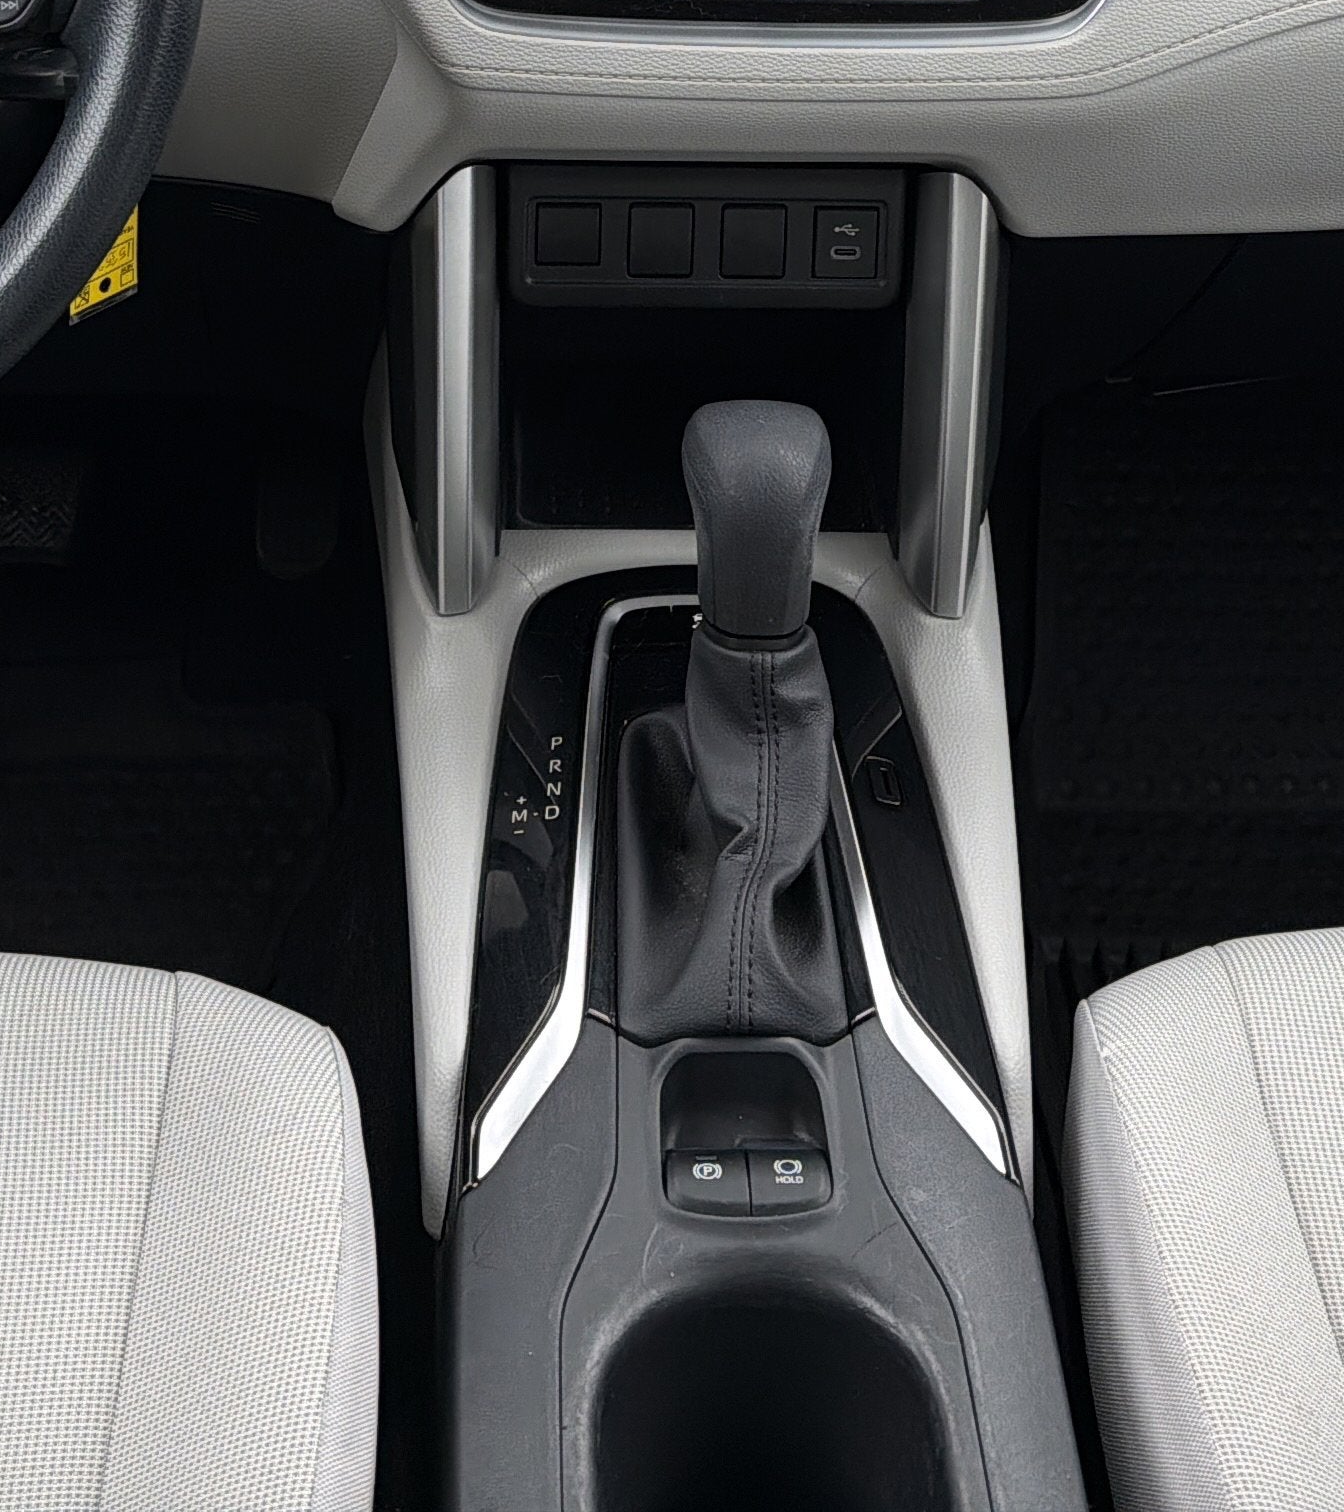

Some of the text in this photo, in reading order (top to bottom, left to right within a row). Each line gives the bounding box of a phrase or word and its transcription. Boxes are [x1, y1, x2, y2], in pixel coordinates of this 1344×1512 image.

[551, 736, 563, 751] P
[549, 759, 562, 774] R
[546, 781, 562, 797] N
[511, 805, 560, 824] M D
[775, 1175, 804, 1184] HOLD
